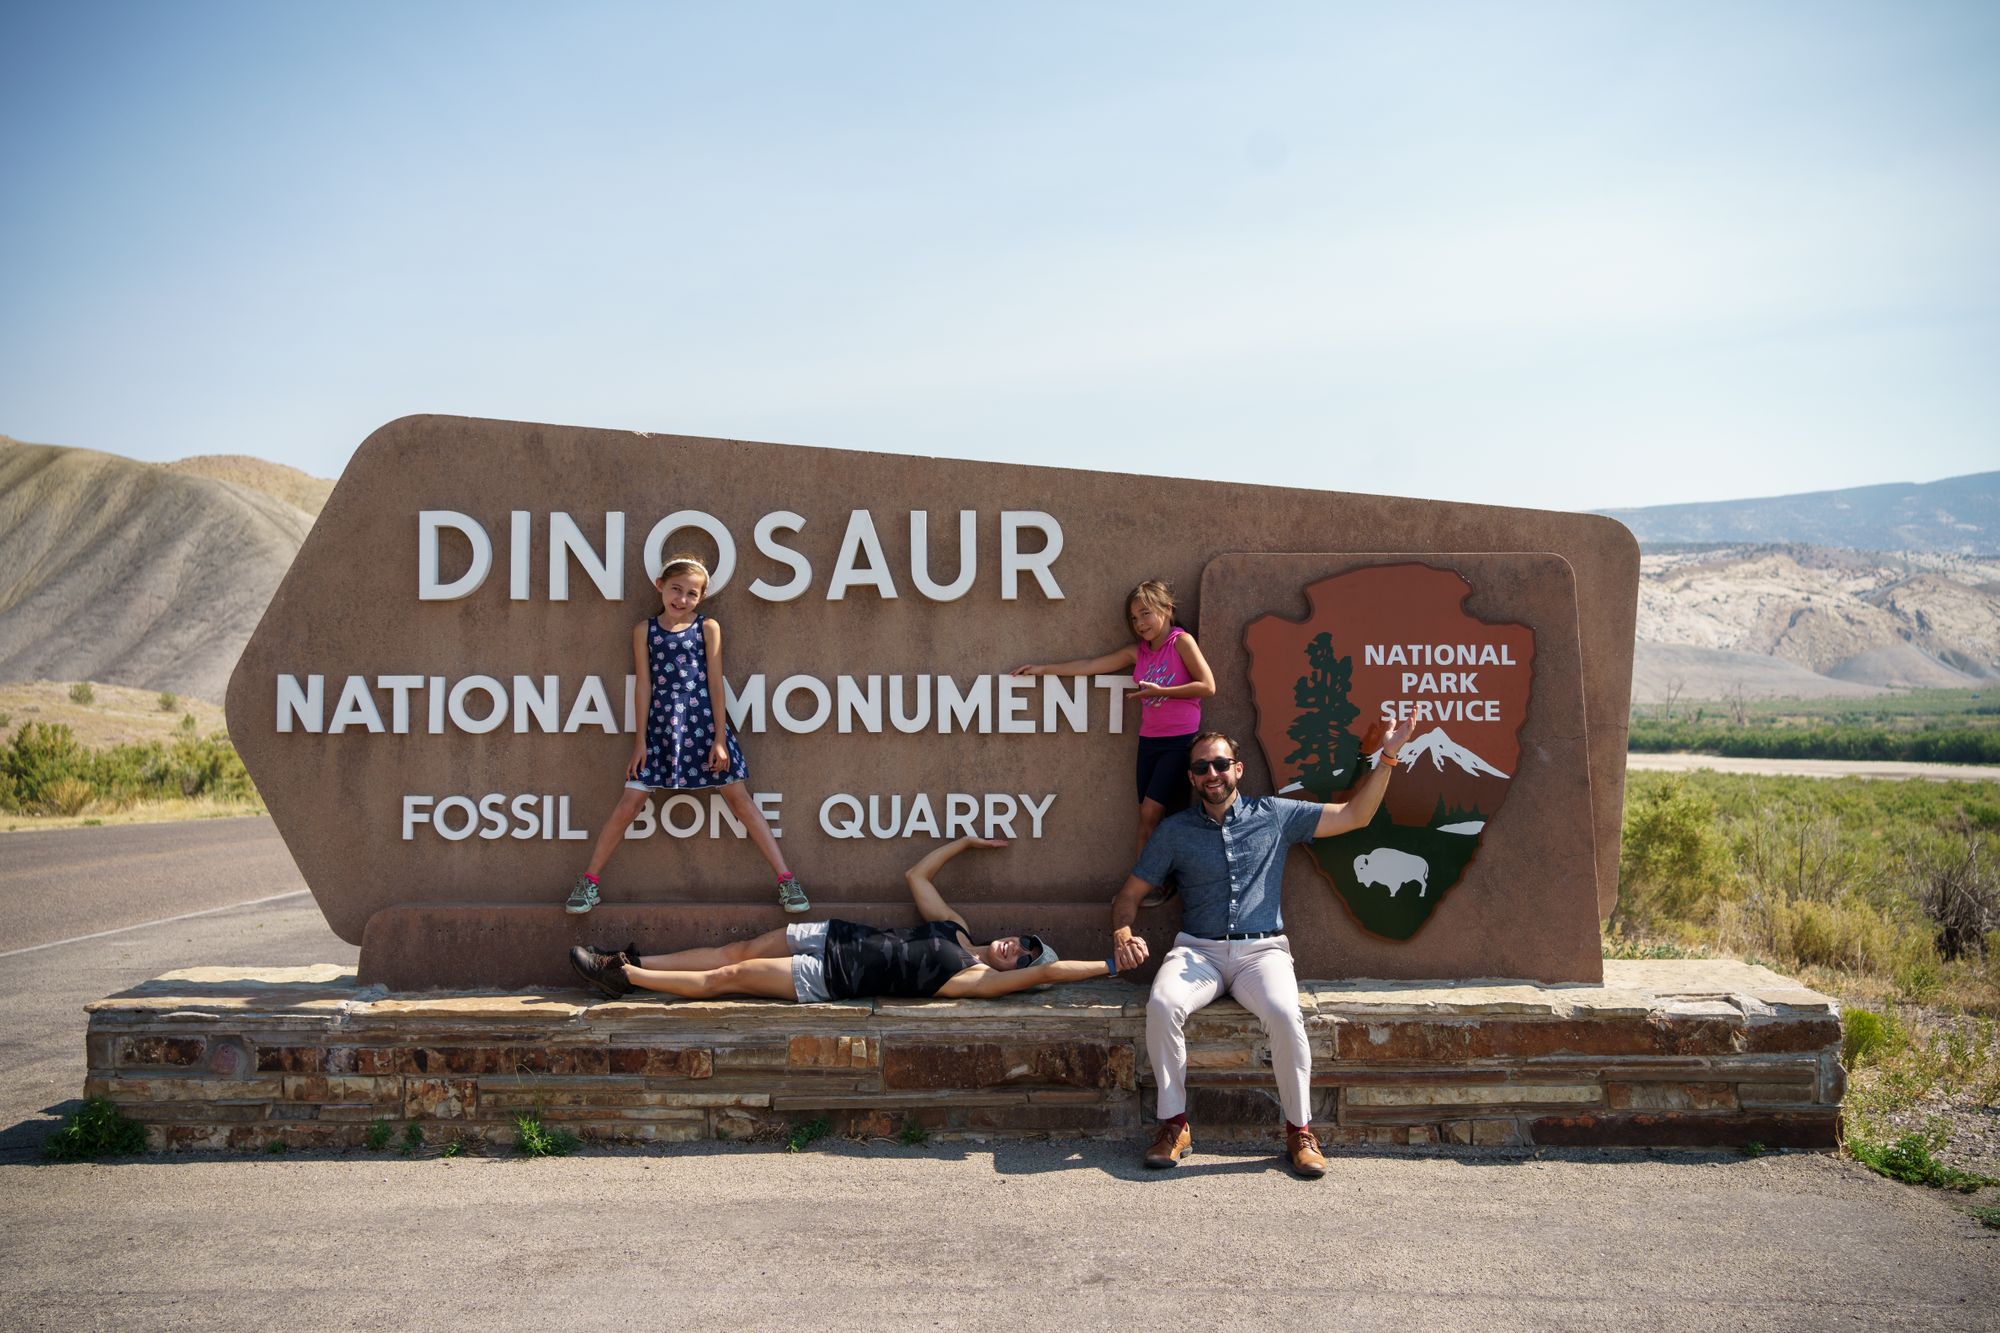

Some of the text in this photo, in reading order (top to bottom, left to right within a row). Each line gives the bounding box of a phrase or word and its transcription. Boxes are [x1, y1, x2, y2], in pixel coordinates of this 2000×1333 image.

[418, 509, 1066, 601] DINOSAUR
[1364, 644, 1516, 666] NATIONAL
[1402, 672, 1479, 694] PARK
[722, 673, 1140, 735] MONUMENT
[1380, 700, 1501, 722] SERVICE
[402, 793, 588, 841] FOSSIL
[819, 793, 1057, 840] QUARRY
